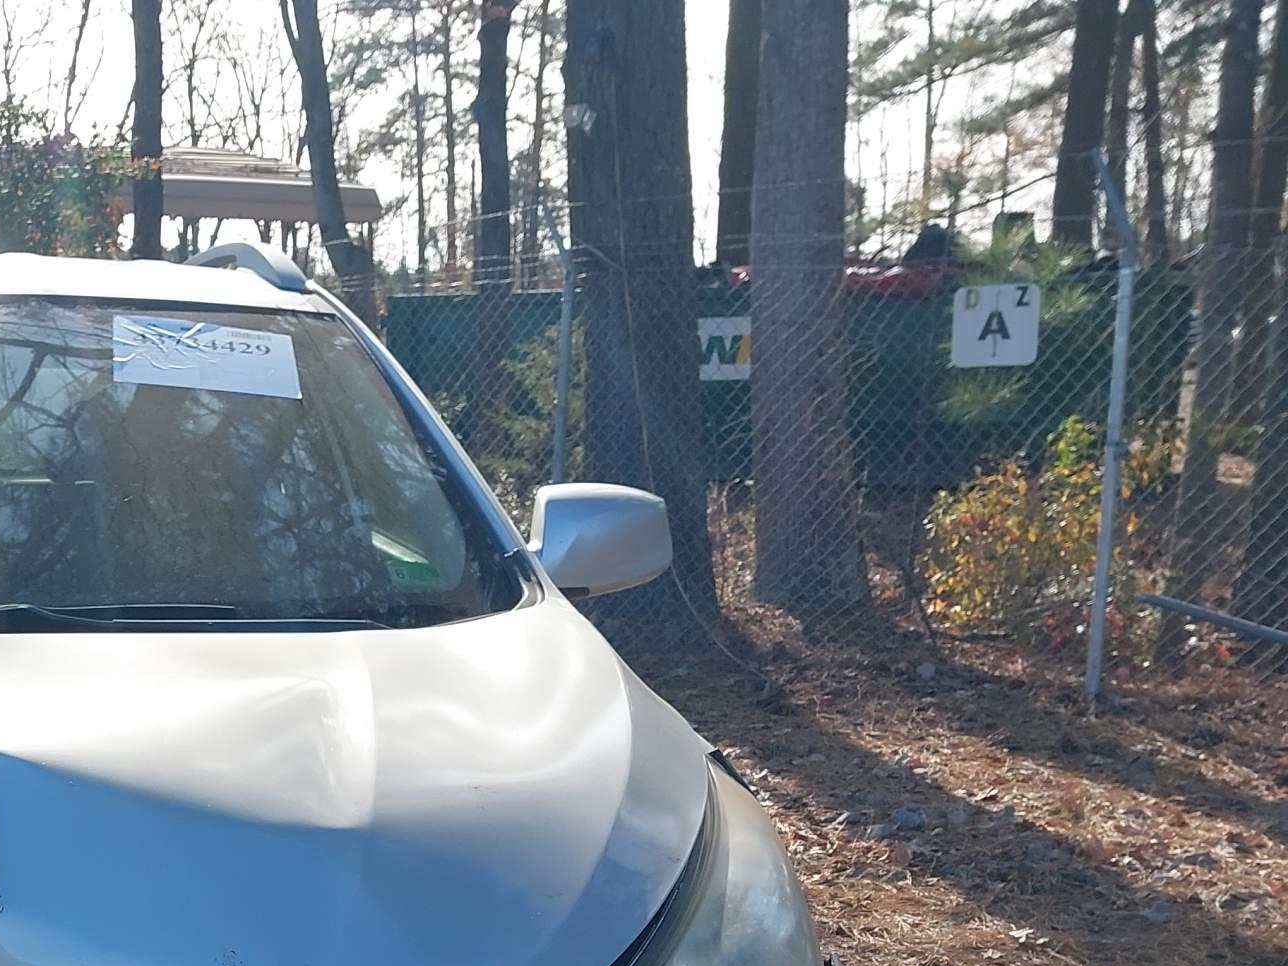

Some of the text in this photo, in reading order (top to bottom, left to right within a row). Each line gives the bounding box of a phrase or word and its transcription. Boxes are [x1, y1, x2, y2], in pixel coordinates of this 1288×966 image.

[965, 286, 1031, 310] D Z
[977, 310, 1011, 341] A
[134, 332, 272, 356] 4429
